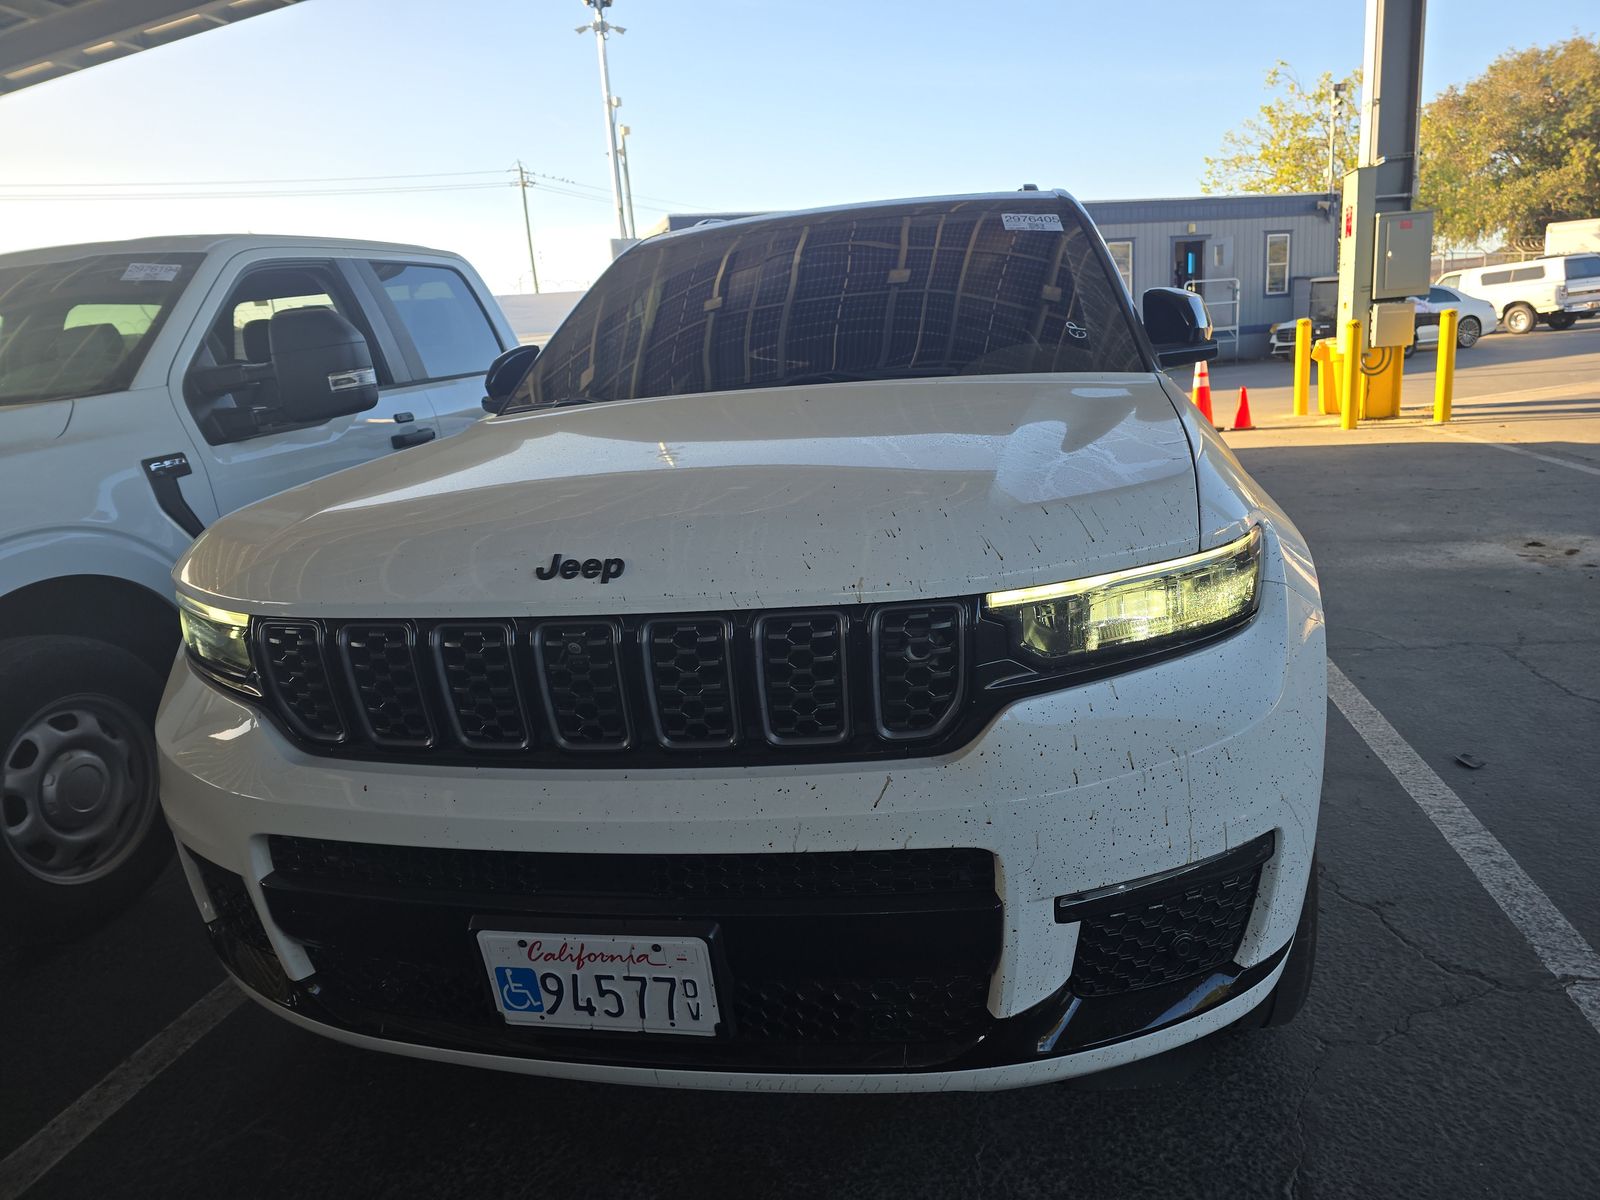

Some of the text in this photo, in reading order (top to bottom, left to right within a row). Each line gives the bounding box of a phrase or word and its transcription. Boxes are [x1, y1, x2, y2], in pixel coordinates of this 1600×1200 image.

[1004, 215, 1060, 224] 2976405
[535, 553, 626, 584] Jeep
[527, 940, 667, 970] California
[539, 972, 677, 1020] 94577
